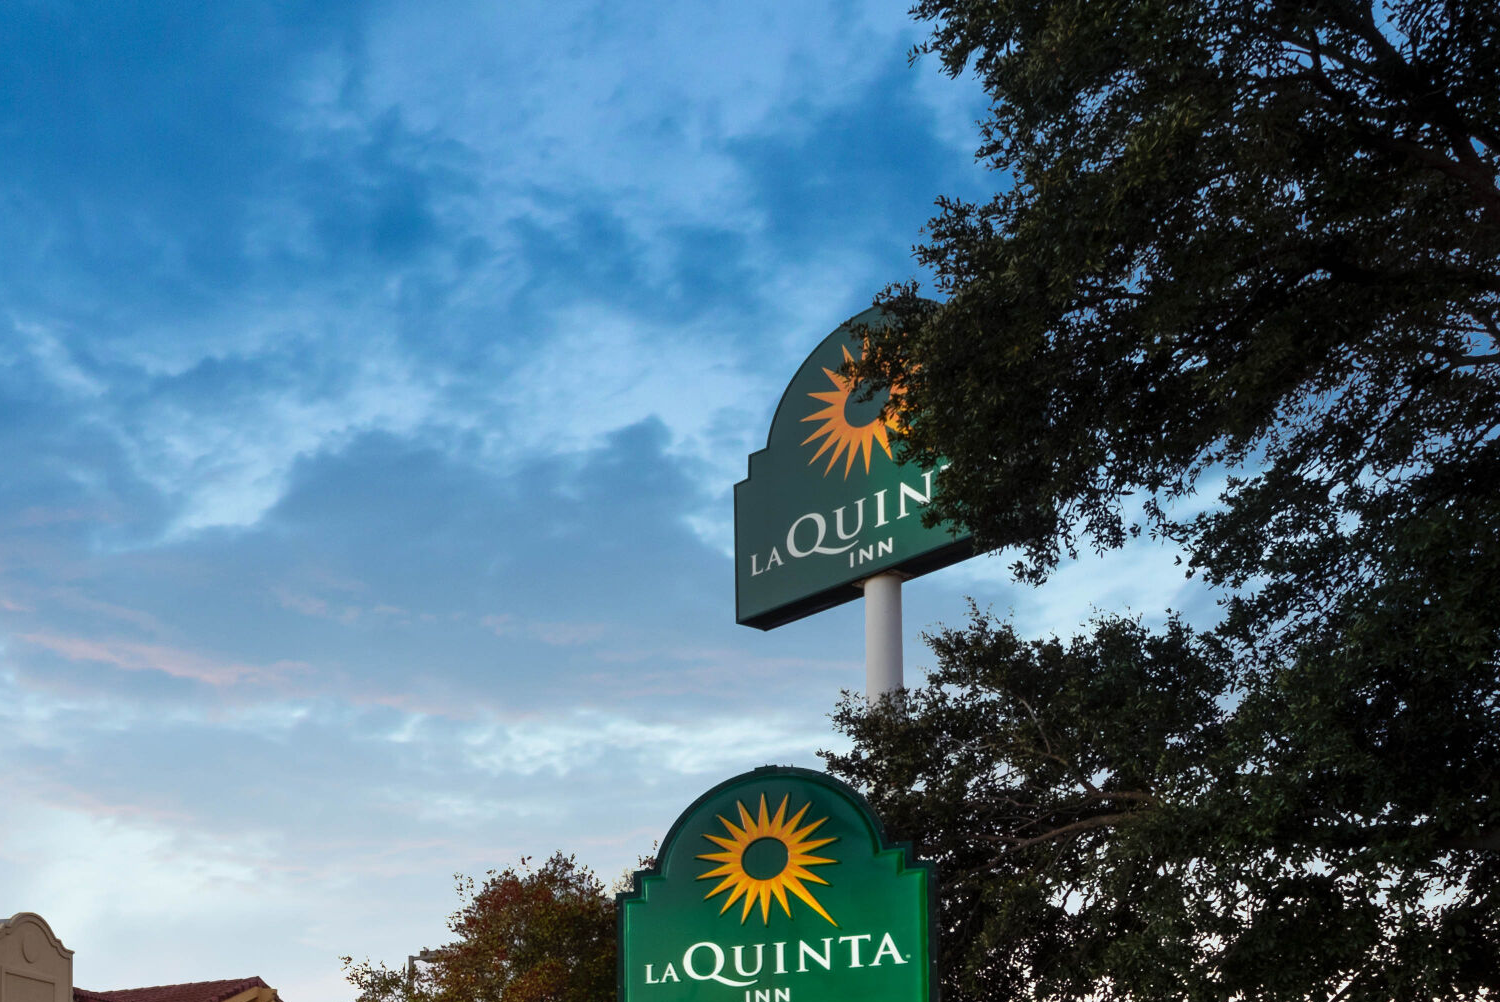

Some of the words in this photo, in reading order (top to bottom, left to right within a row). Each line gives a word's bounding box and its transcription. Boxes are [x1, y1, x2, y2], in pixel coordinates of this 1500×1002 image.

[751, 545, 785, 577] LA
[785, 463, 952, 559] QUIN
[849, 537, 893, 568] INN
[644, 961, 681, 985] LA
[682, 932, 909, 987] QUINTA
